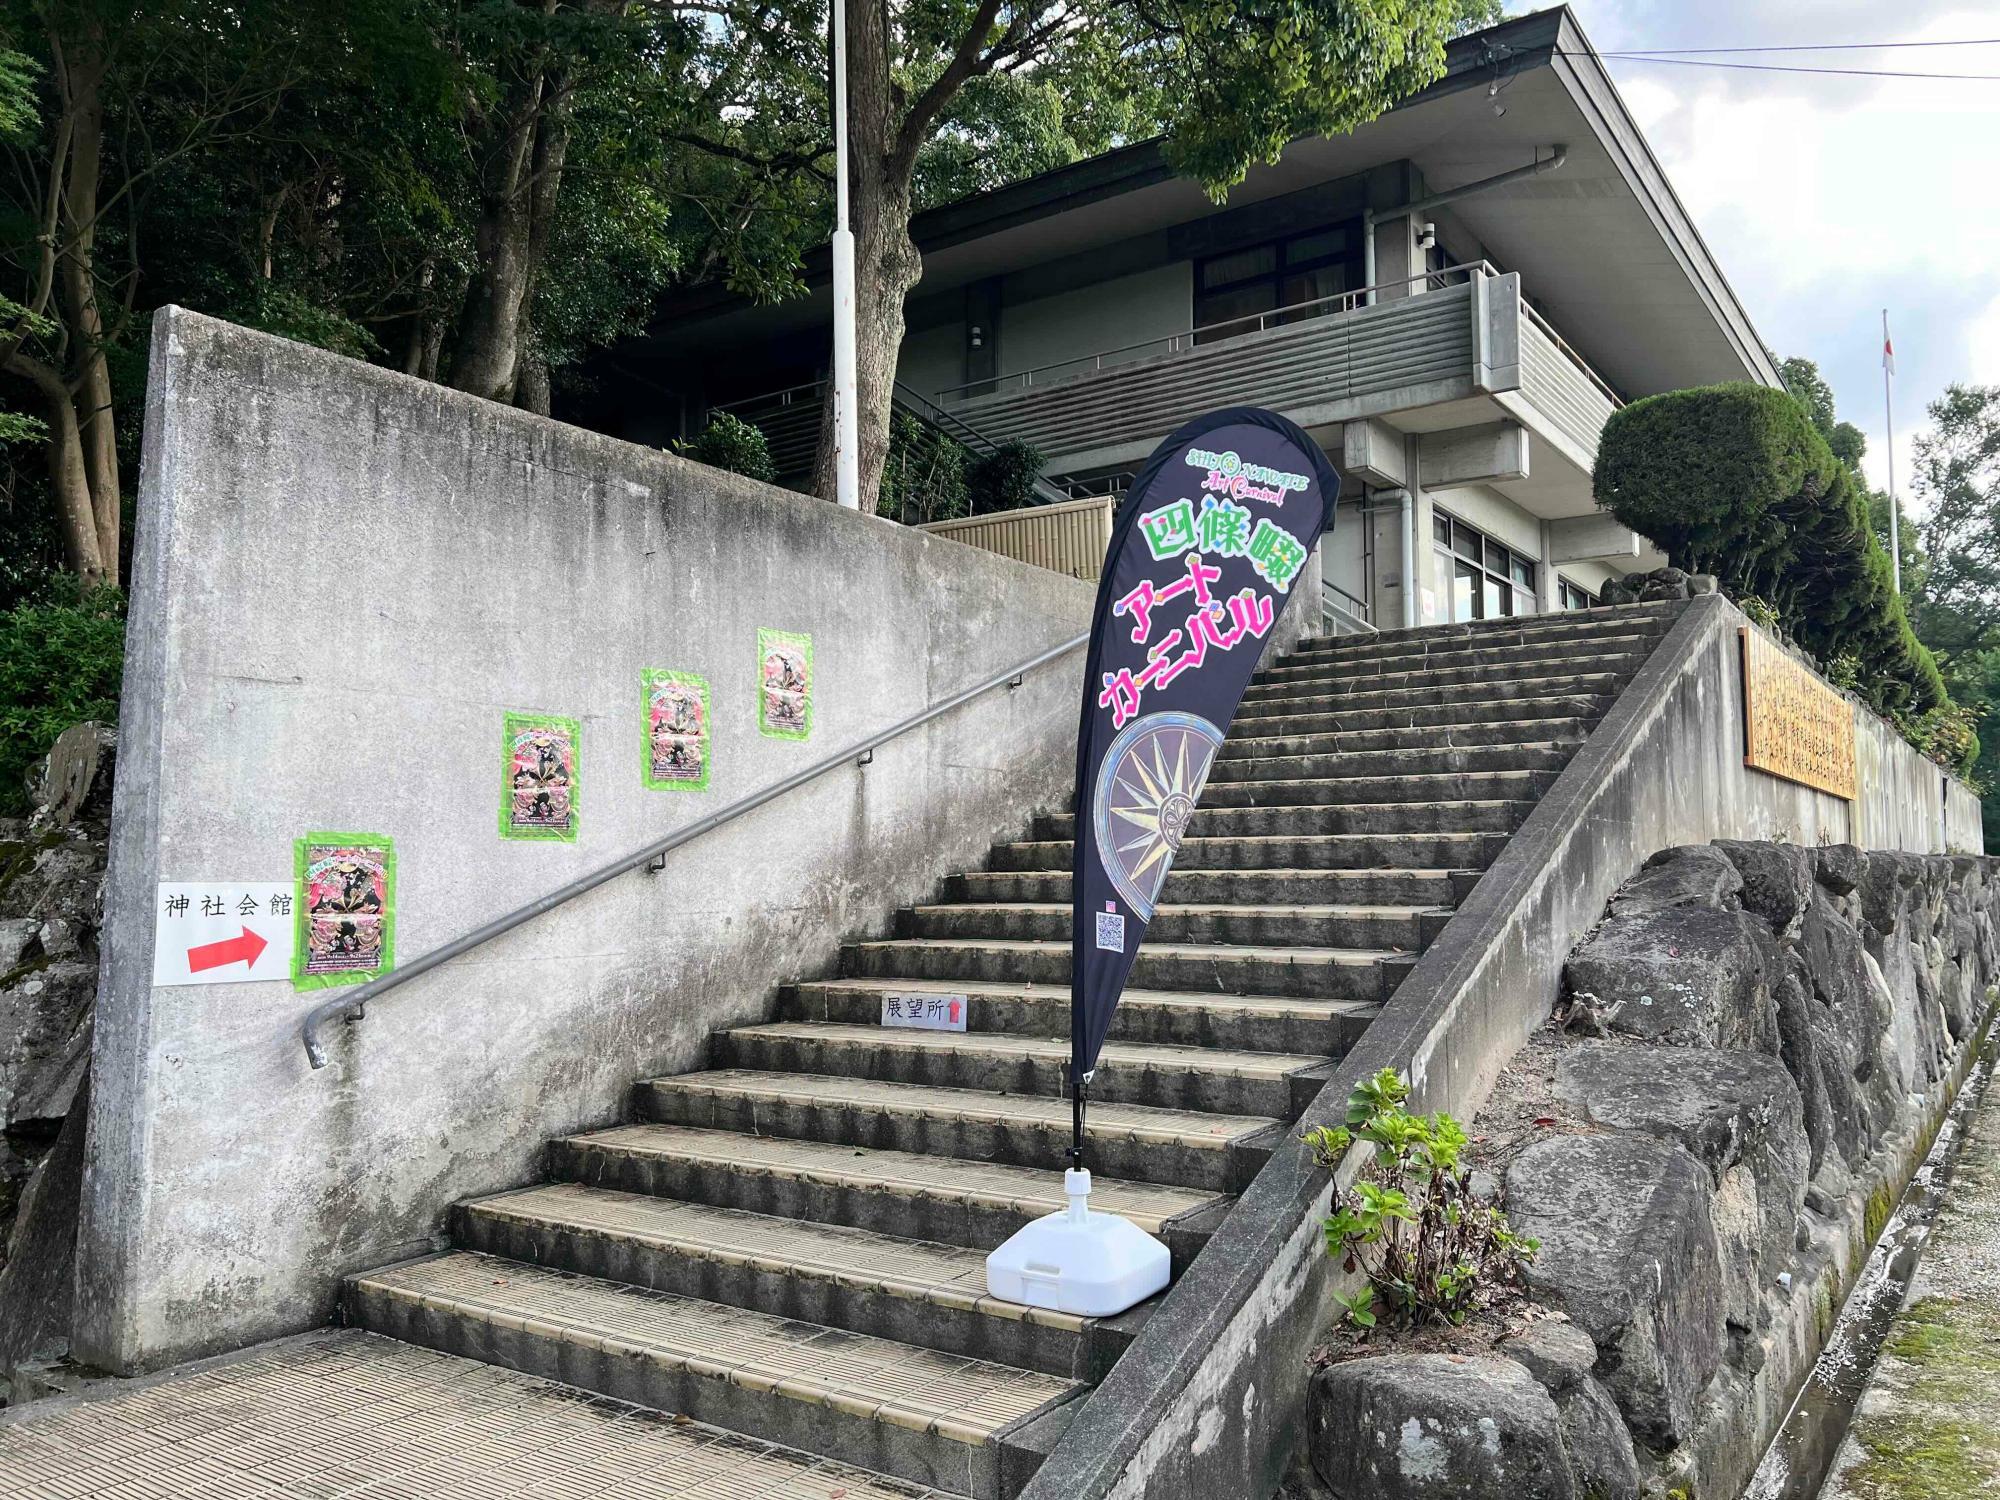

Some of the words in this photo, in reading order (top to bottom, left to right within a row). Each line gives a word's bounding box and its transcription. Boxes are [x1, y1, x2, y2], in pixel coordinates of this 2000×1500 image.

[1201, 471, 1231, 494] Art
[1230, 475, 1287, 508] Carnival
[1139, 495, 1307, 592] 四條畷
[1114, 553, 1221, 643] アート
[1099, 588, 1273, 729] カーニバル
[164, 893, 293, 918] 神社会館
[886, 997, 944, 1021] 展望所
